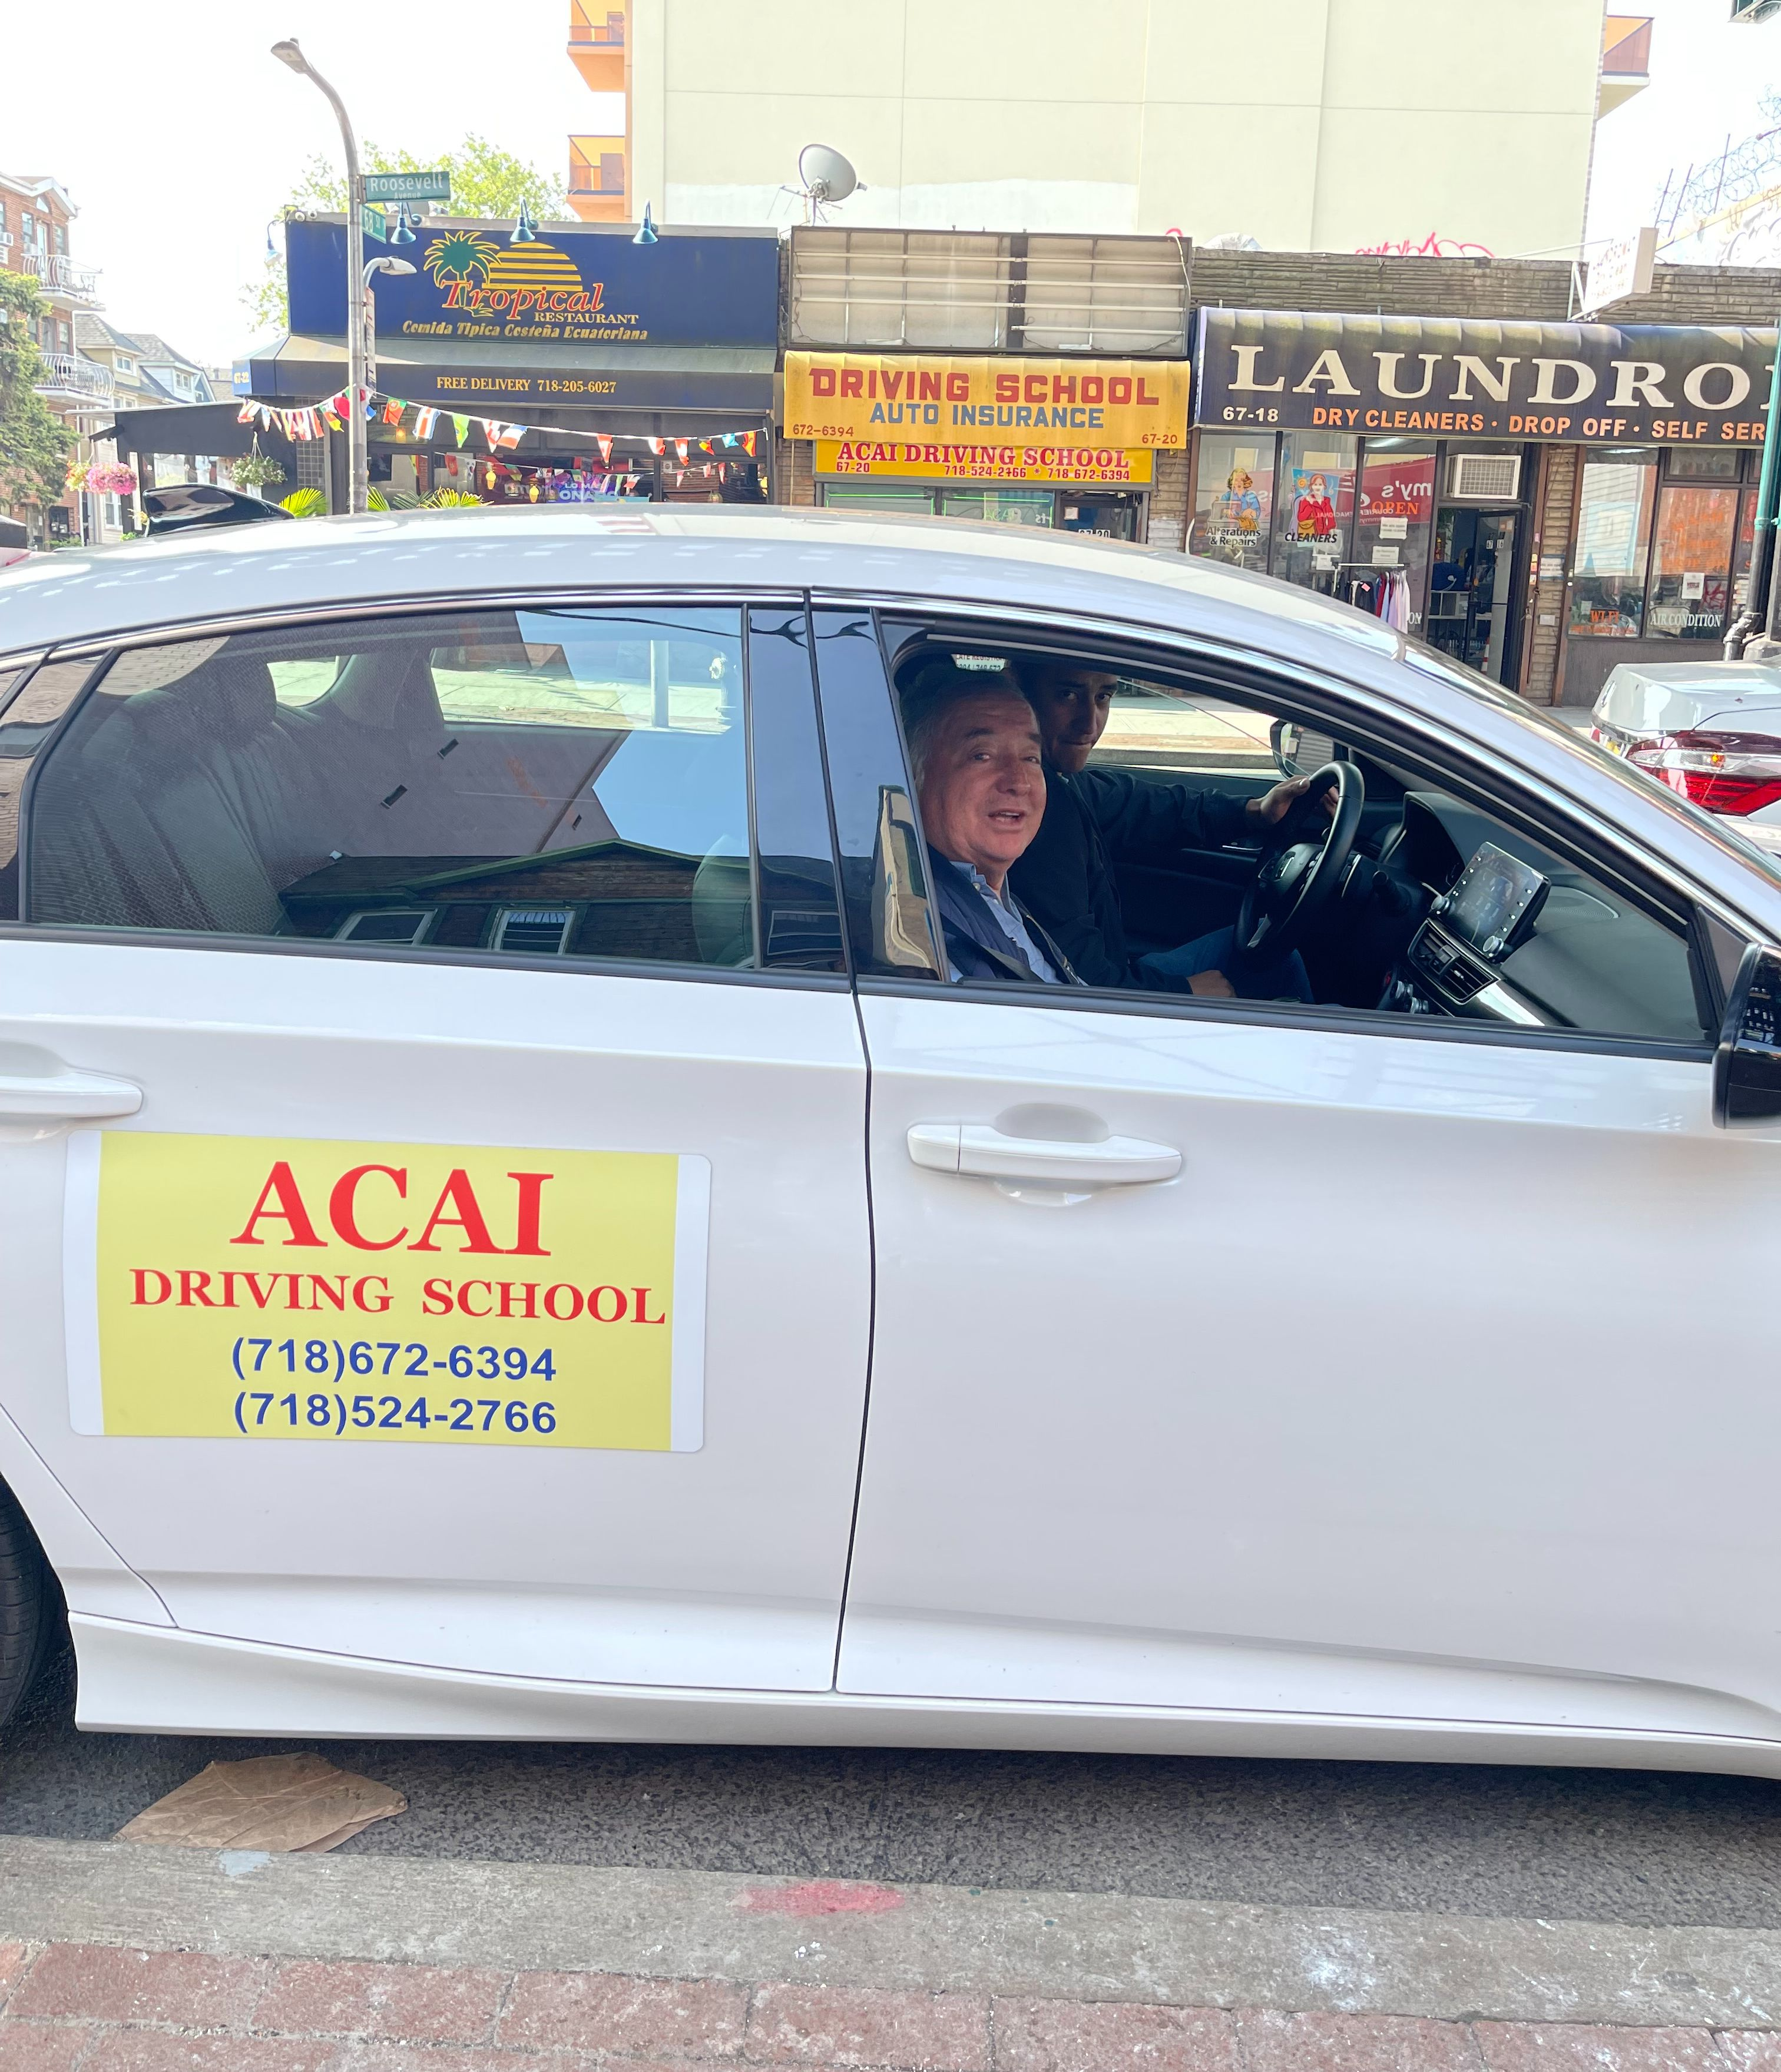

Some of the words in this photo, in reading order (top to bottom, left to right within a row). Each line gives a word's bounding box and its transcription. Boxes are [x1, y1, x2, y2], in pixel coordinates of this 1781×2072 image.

[370, 172, 443, 191] Roosevelt
[364, 209, 373, 233] 68
[441, 279, 604, 320] Tropical
[534, 312, 639, 324] RESTAURANT
[402, 320, 452, 334] Comida
[504, 324, 560, 338] Costeña
[564, 326, 648, 340] Ecuatoriana
[436, 377, 468, 389] FREE
[471, 378, 531, 391] DELIVERY
[537, 379, 617, 393] 718-205-6027
[1227, 343, 1775, 410] LAUNDRO
[809, 368, 969, 402] DRIVING
[995, 374, 1159, 405] SCHOOL
[870, 403, 938, 425] AUTO
[953, 405, 1104, 429] INSURANCE
[1223, 407, 1279, 422] 67-18
[1313, 407, 1360, 426] DRY
[1365, 409, 1484, 431] CLEANERS
[1509, 416, 1571, 435] DROP
[1583, 417, 1626, 436] OFF
[1651, 420, 1708, 439] SELF
[793, 424, 854, 437] 672-6394
[1141, 433, 1178, 445] 67-20
[837, 442, 897, 461] ACAI
[904, 445, 1015, 465] DRIVING
[1024, 448, 1128, 468] SCHOOL
[836, 462, 869, 472] 67-20
[1372, 501, 1419, 515] OPEN
[1207, 527, 1261, 537] Alterations
[1285, 532, 1338, 543] CLEANERS
[1220, 537, 1256, 548] Repairs
[1650, 613, 1666, 625] AIR
[1669, 614, 1722, 627] CONDITION
[229, 1161, 554, 1257] ACAI
[129, 1268, 394, 1313] DRIVING
[422, 1278, 666, 1324] SCHOOL
[232, 1337, 557, 1382] (718)672-6394
[234, 1393, 558, 1435] (718)524-2766
